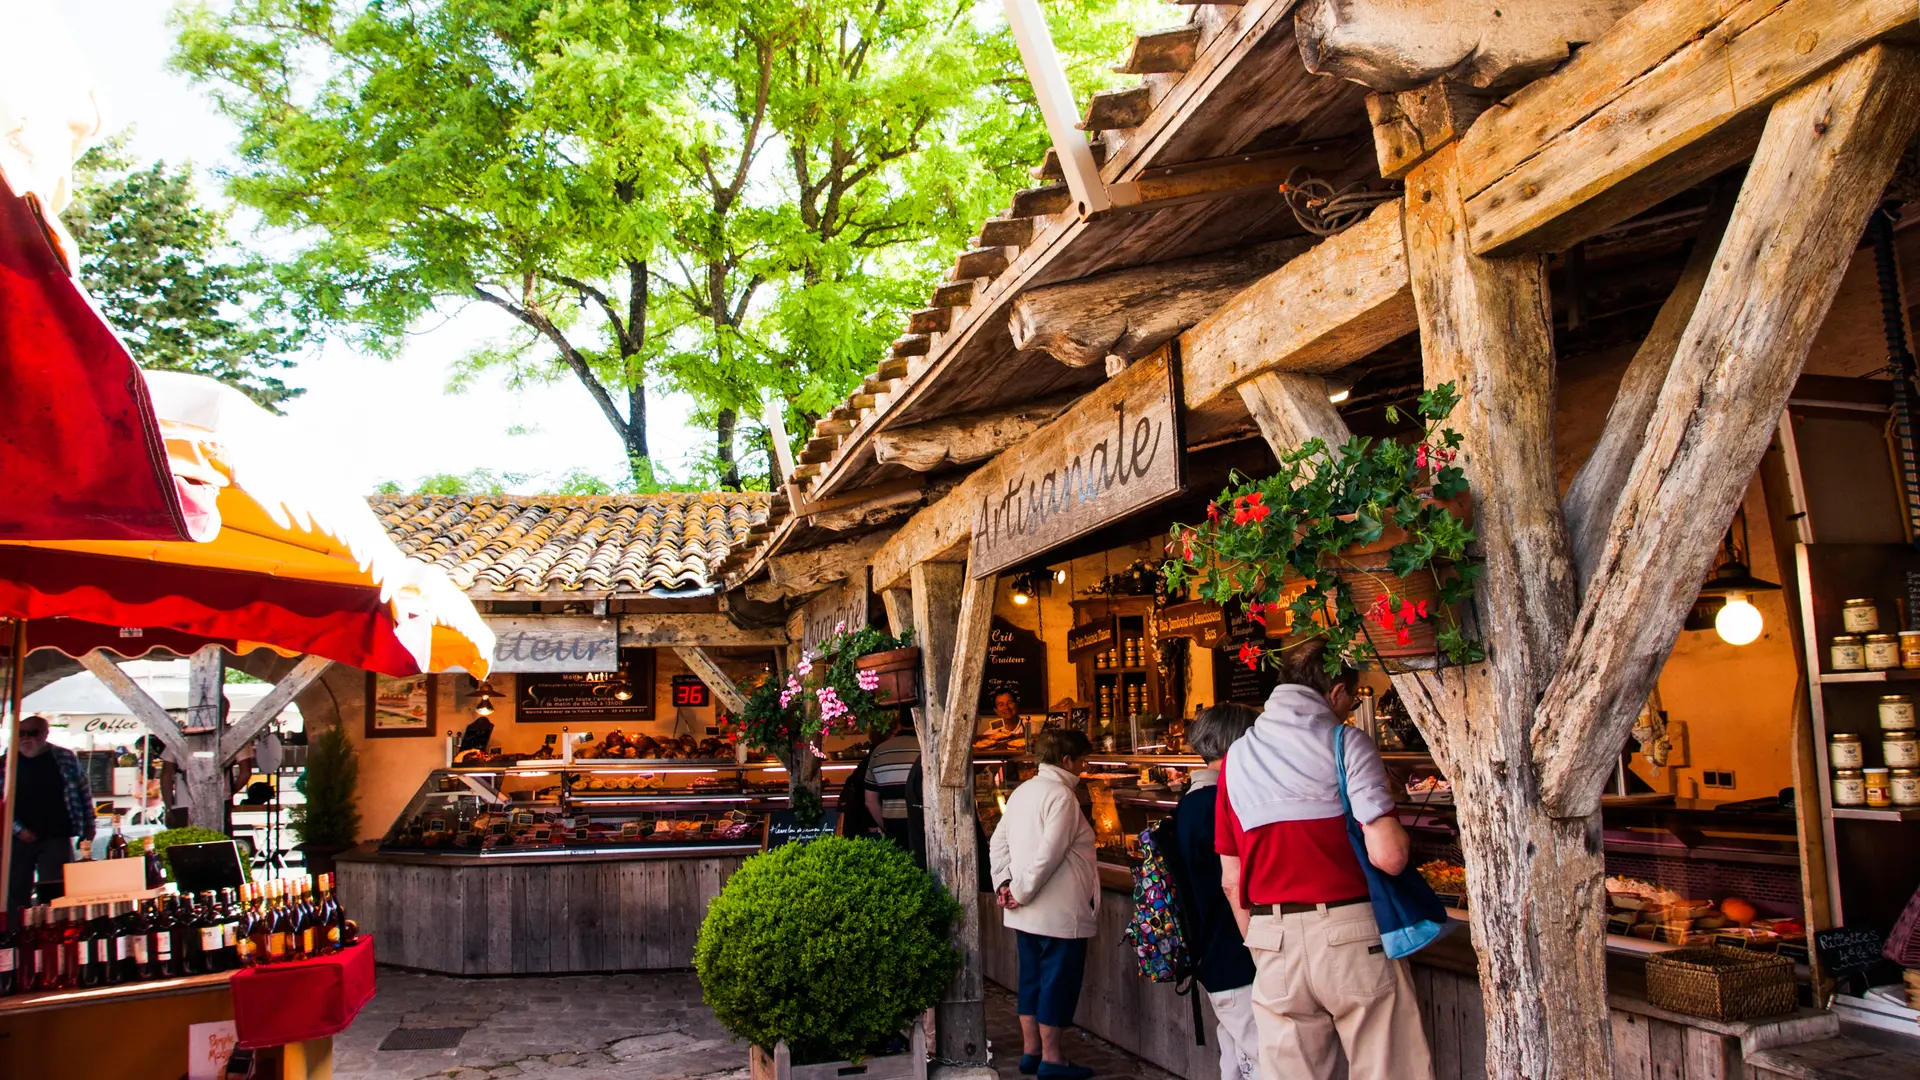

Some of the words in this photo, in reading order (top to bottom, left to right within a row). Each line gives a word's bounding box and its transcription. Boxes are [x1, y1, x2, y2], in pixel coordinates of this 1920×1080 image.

[975, 400, 1162, 557] Artisanale
[494, 630, 611, 662] iteur
[677, 686, 702, 704] 36
[84, 718, 138, 733] Coffee
